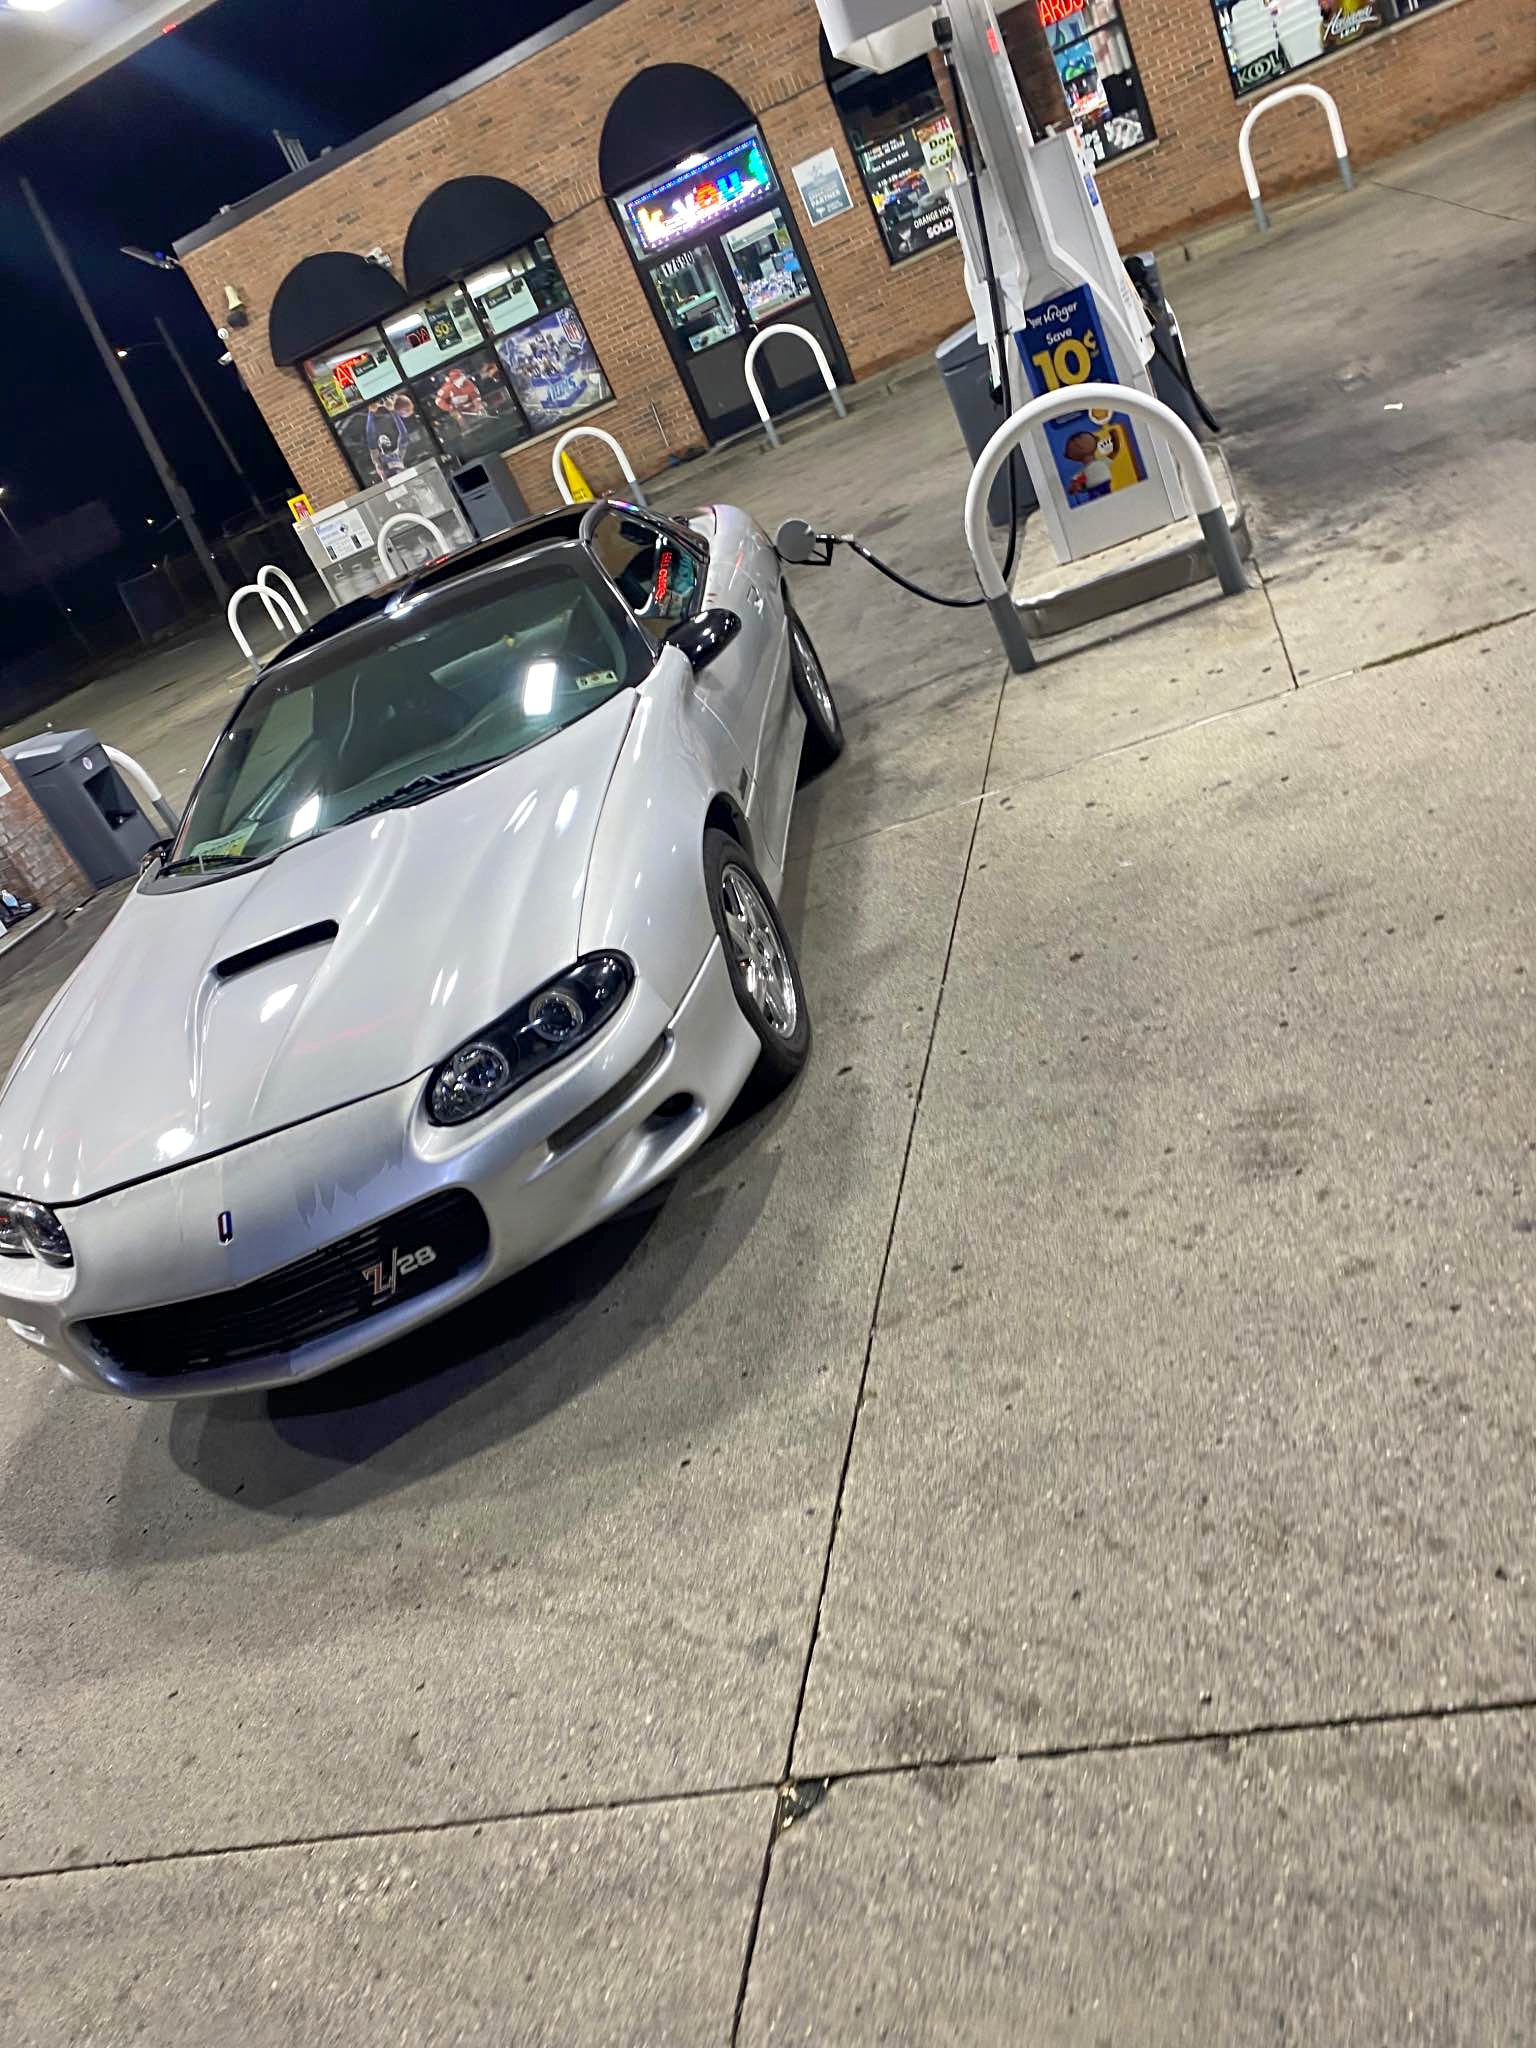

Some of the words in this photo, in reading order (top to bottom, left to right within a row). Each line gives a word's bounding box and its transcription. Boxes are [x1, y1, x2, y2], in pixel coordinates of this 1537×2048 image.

[1237, 55, 1282, 88] KOOL
[913, 210, 940, 229] ORANGE
[926, 218, 954, 239] SOLD
[1044, 303, 1078, 325] Kroger
[1046, 327, 1071, 346] Save
[361, 1245, 438, 1296] Z/28
